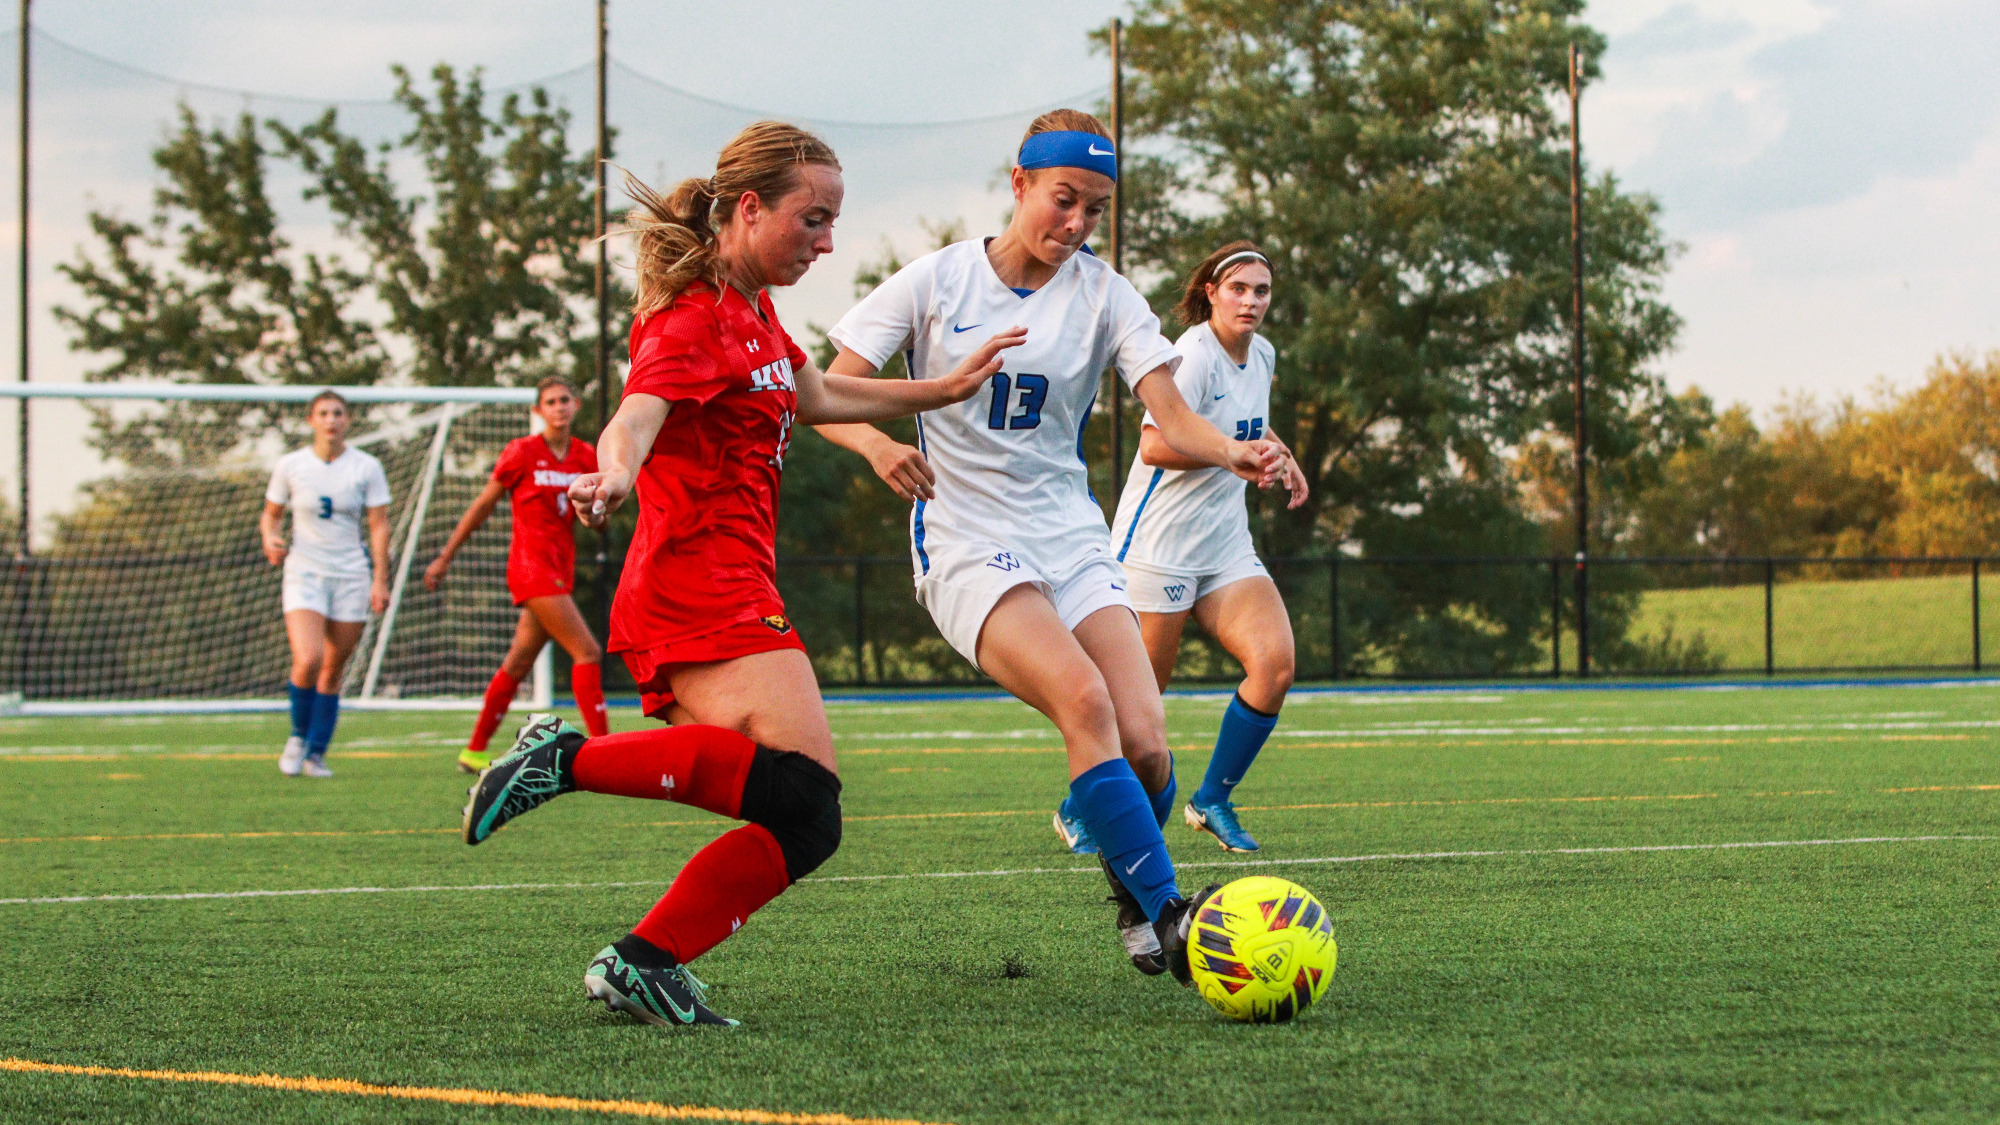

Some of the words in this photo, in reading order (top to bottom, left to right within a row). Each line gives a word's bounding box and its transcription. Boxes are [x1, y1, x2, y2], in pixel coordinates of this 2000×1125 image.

[988, 372, 1049, 430] 13
[318, 496, 332, 518] 3
[1164, 584, 1186, 602] W
